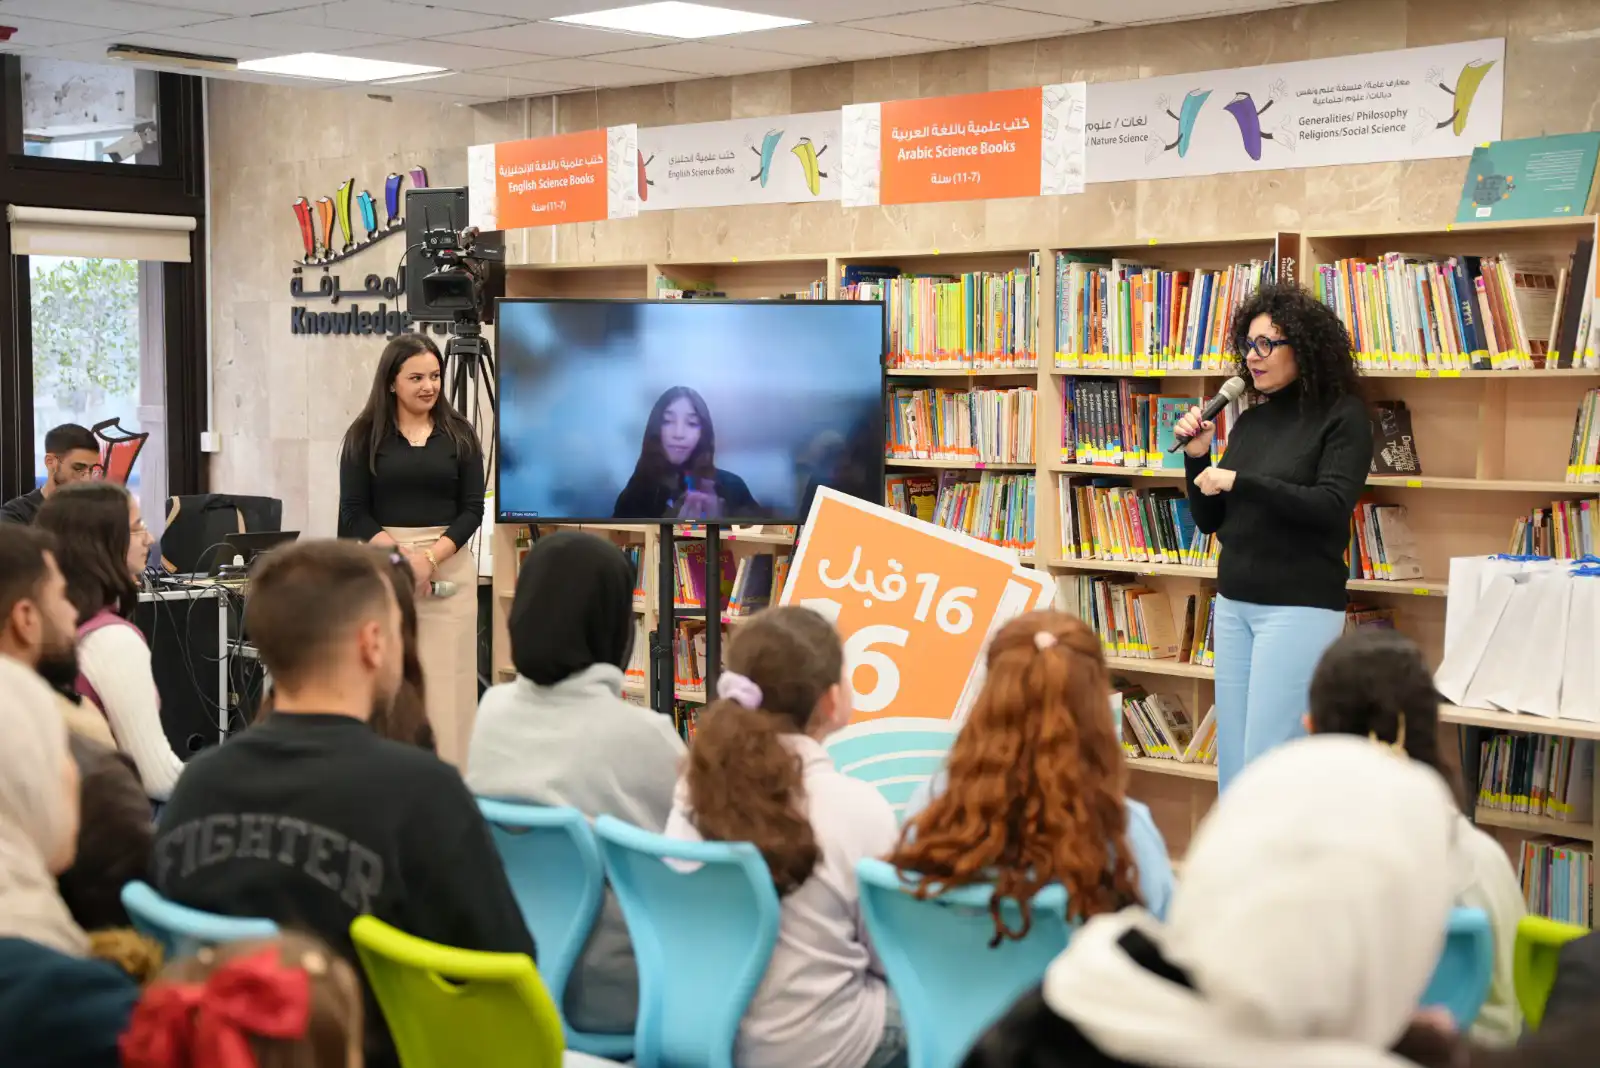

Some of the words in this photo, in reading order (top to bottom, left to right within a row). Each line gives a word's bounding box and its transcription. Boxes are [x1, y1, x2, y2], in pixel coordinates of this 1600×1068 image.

[1003, 117, 1030, 132] كتب
[1121, 114, 1147, 127] لغات
[1299, 112, 1355, 126] Generalities/
[1356, 108, 1408, 121] Philosophy
[891, 126, 929, 141] العربية
[931, 122, 966, 137] باللغة
[967, 120, 1001, 136] علمية
[1085, 119, 1112, 133] علوم
[1299, 125, 1369, 141] Religions/Social
[1371, 123, 1406, 134] Science
[1091, 136, 1117, 146] Nature
[1119, 133, 1148, 144] Science
[695, 152, 716, 163] علمية
[719, 149, 735, 160] كتب
[897, 146, 933, 161] Arabic
[935, 143, 978, 158] Science
[980, 140, 1016, 155] Books
[535, 159, 559, 171] باللغة
[560, 157, 584, 170] علمية
[584, 154, 604, 167] كتب
[668, 169, 690, 180] English
[691, 167, 715, 178] Science
[715, 165, 735, 175] Books
[930, 172, 952, 184] سنة
[508, 179, 537, 195] English
[538, 177, 569, 189] Science
[570, 173, 595, 186] Books
[531, 202, 546, 212] سنة
[290, 266, 407, 304] لمعرفة
[291, 303, 414, 341] Knowledge
[817, 545, 908, 608] قبل
[914, 573, 977, 634] 16
[155, 812, 384, 915] FIGHTER
